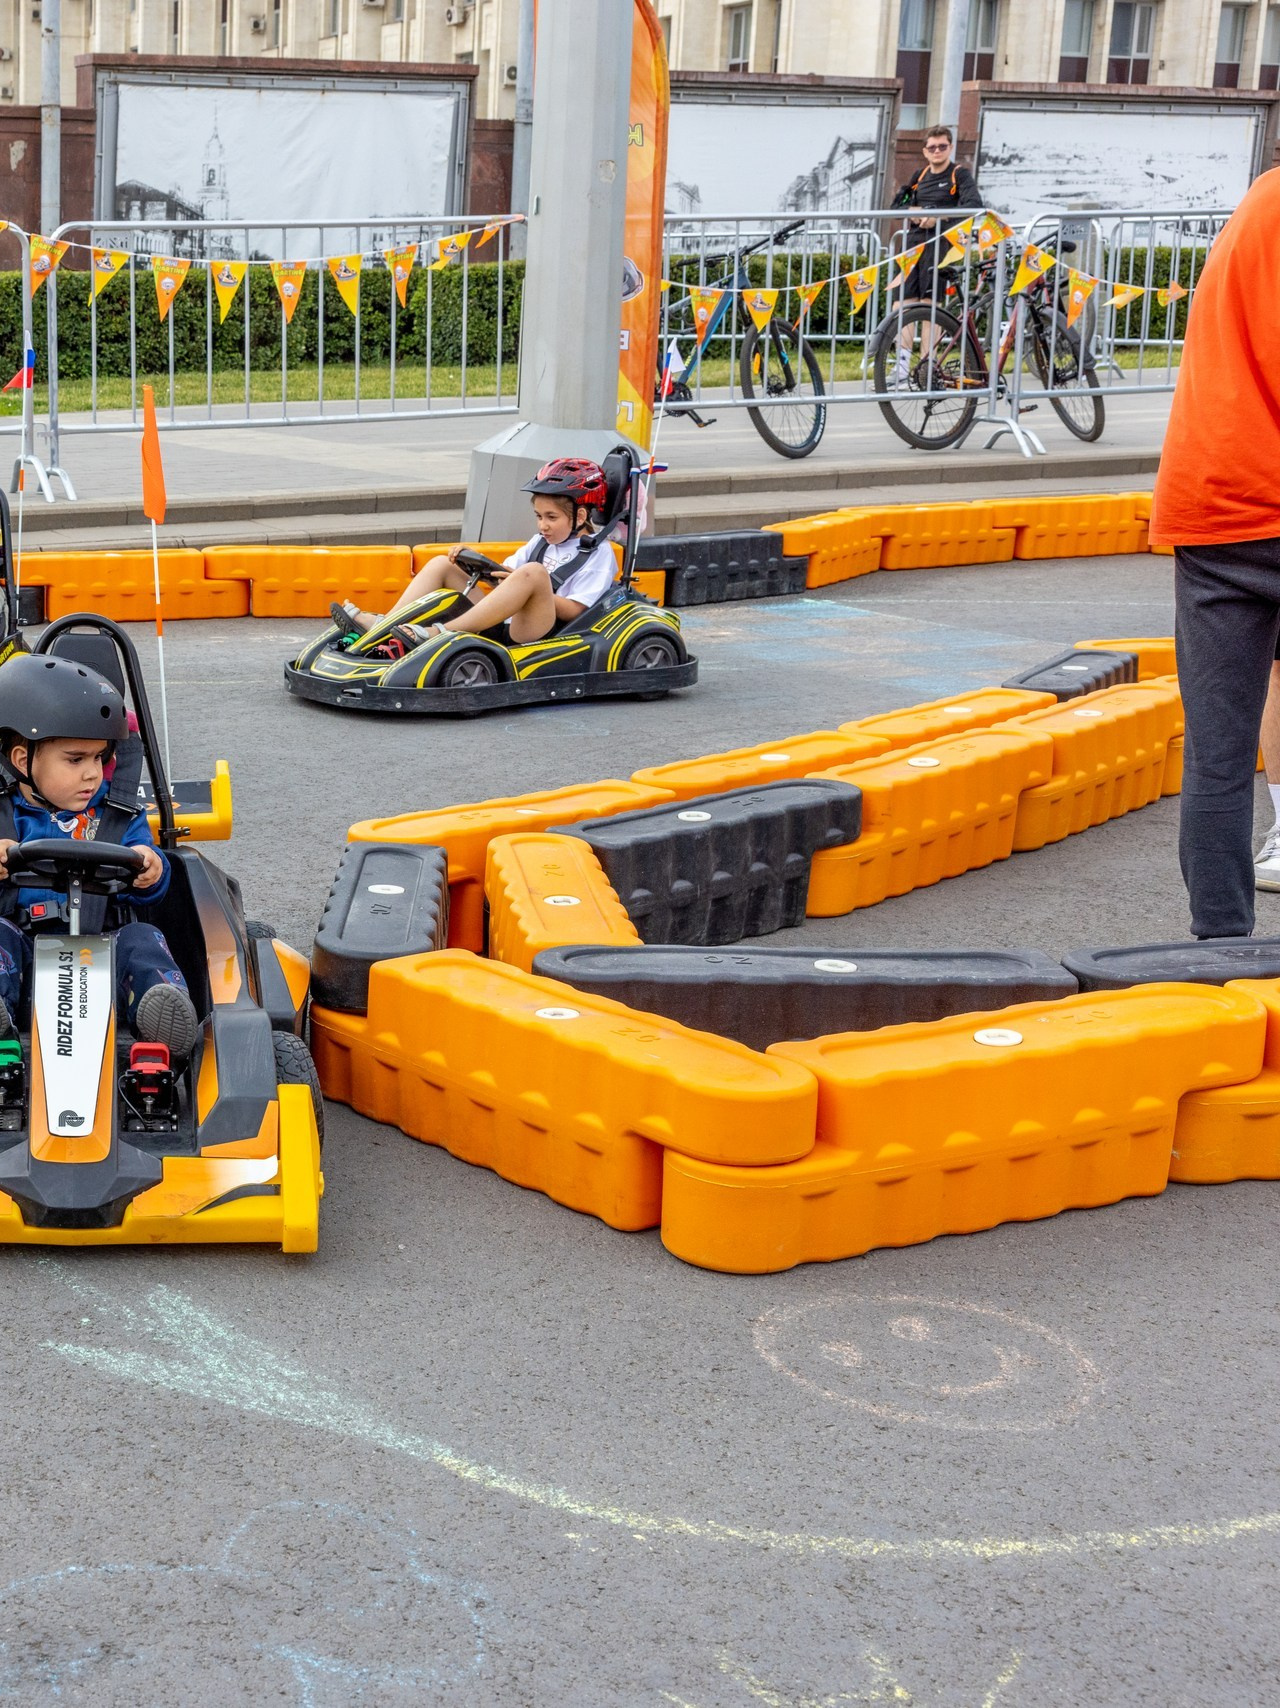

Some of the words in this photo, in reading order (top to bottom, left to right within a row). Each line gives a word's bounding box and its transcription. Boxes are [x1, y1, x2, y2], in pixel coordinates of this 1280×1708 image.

[58, 951, 73, 963] S1
[57, 965, 73, 1018] FORMULA
[79, 967, 88, 1003] EDUCATION
[79, 1005, 88, 1019] FOR
[57, 1020, 72, 1057] RIDEZ
